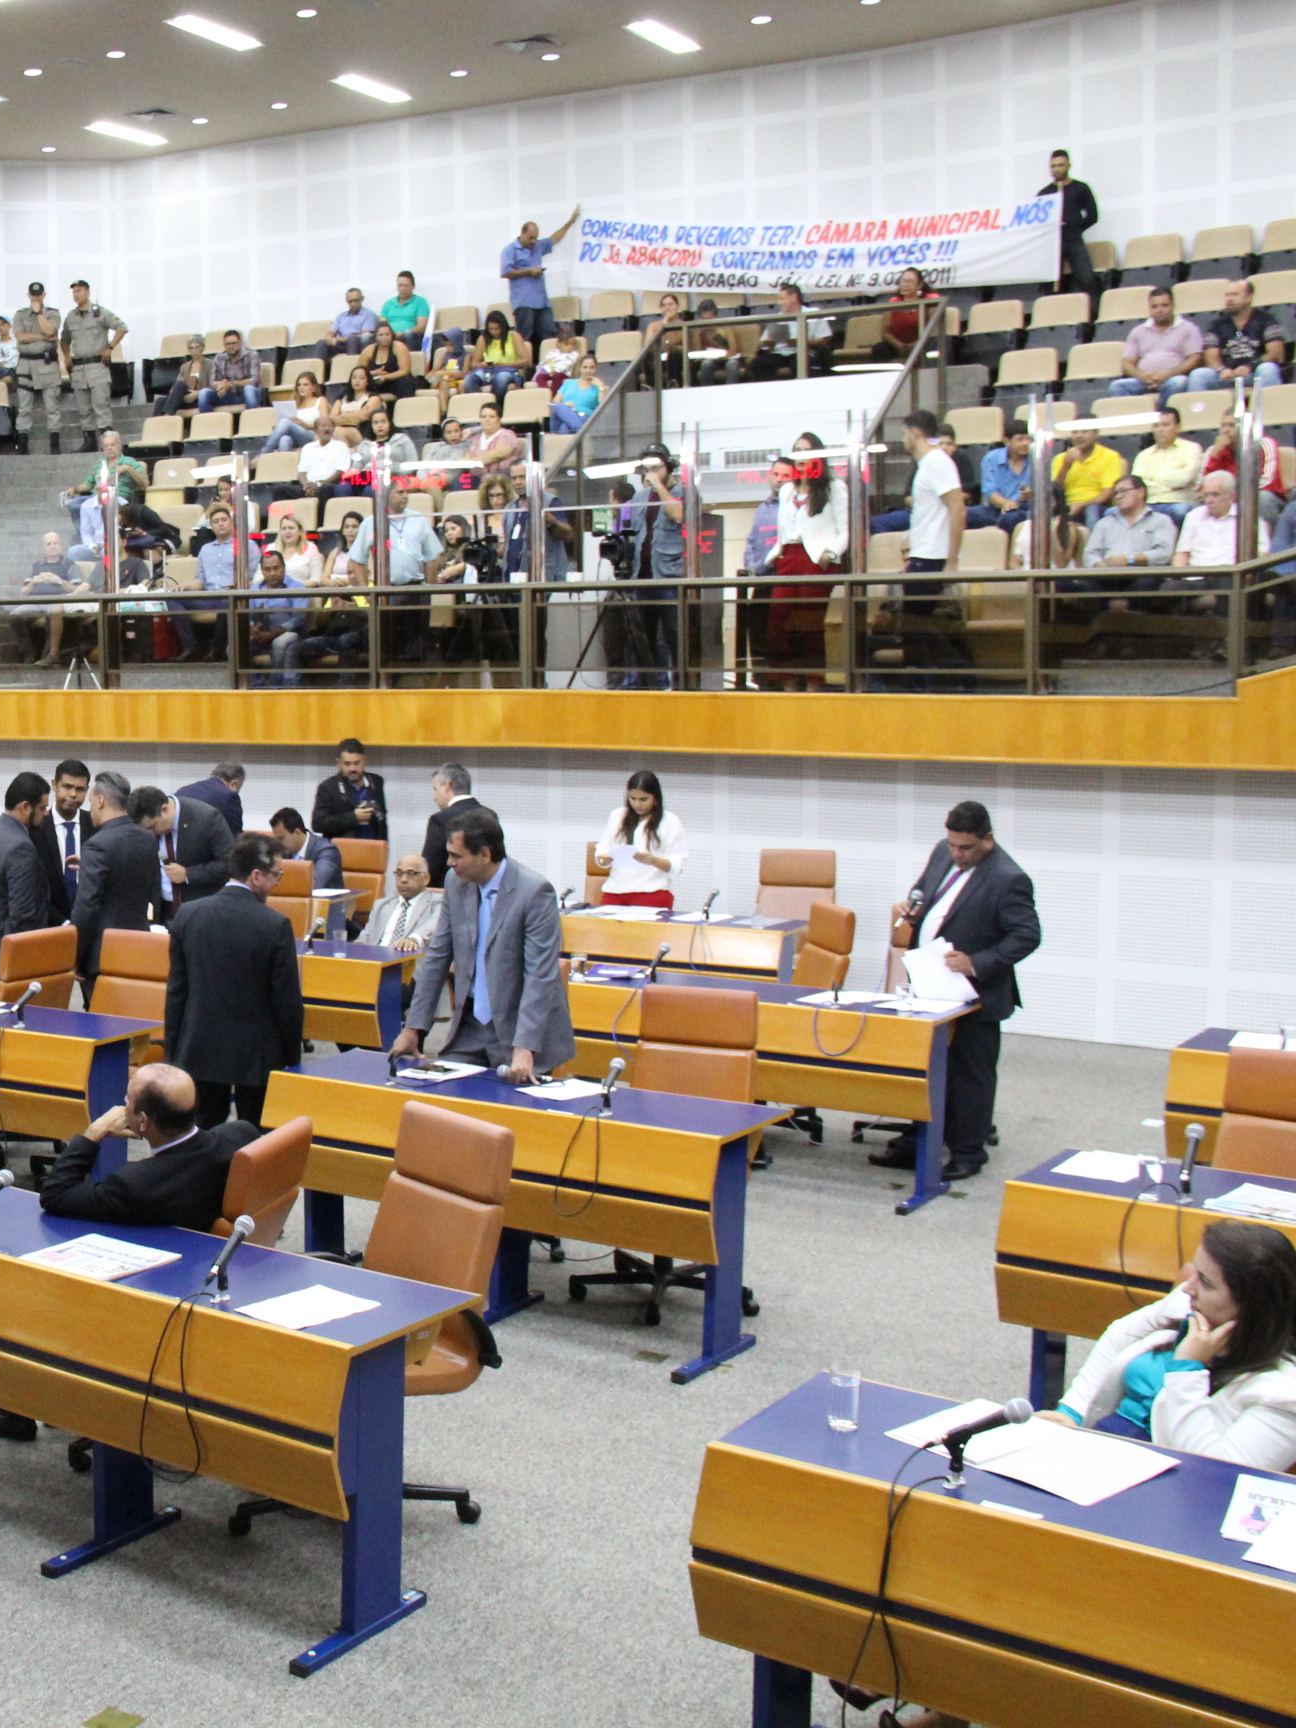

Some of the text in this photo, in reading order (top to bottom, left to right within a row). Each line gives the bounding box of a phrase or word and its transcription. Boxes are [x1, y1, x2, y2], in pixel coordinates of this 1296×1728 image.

[581, 218, 669, 245] CONFIANÇA
[673, 225, 755, 247] DEVEMOS
[758, 224, 804, 247] TER!
[579, 241, 603, 263] DO
[711, 249, 818, 270] CONFIAMOS
[822, 247, 855, 269] EM
[666, 270, 759, 291] REVOGAÇÃO
